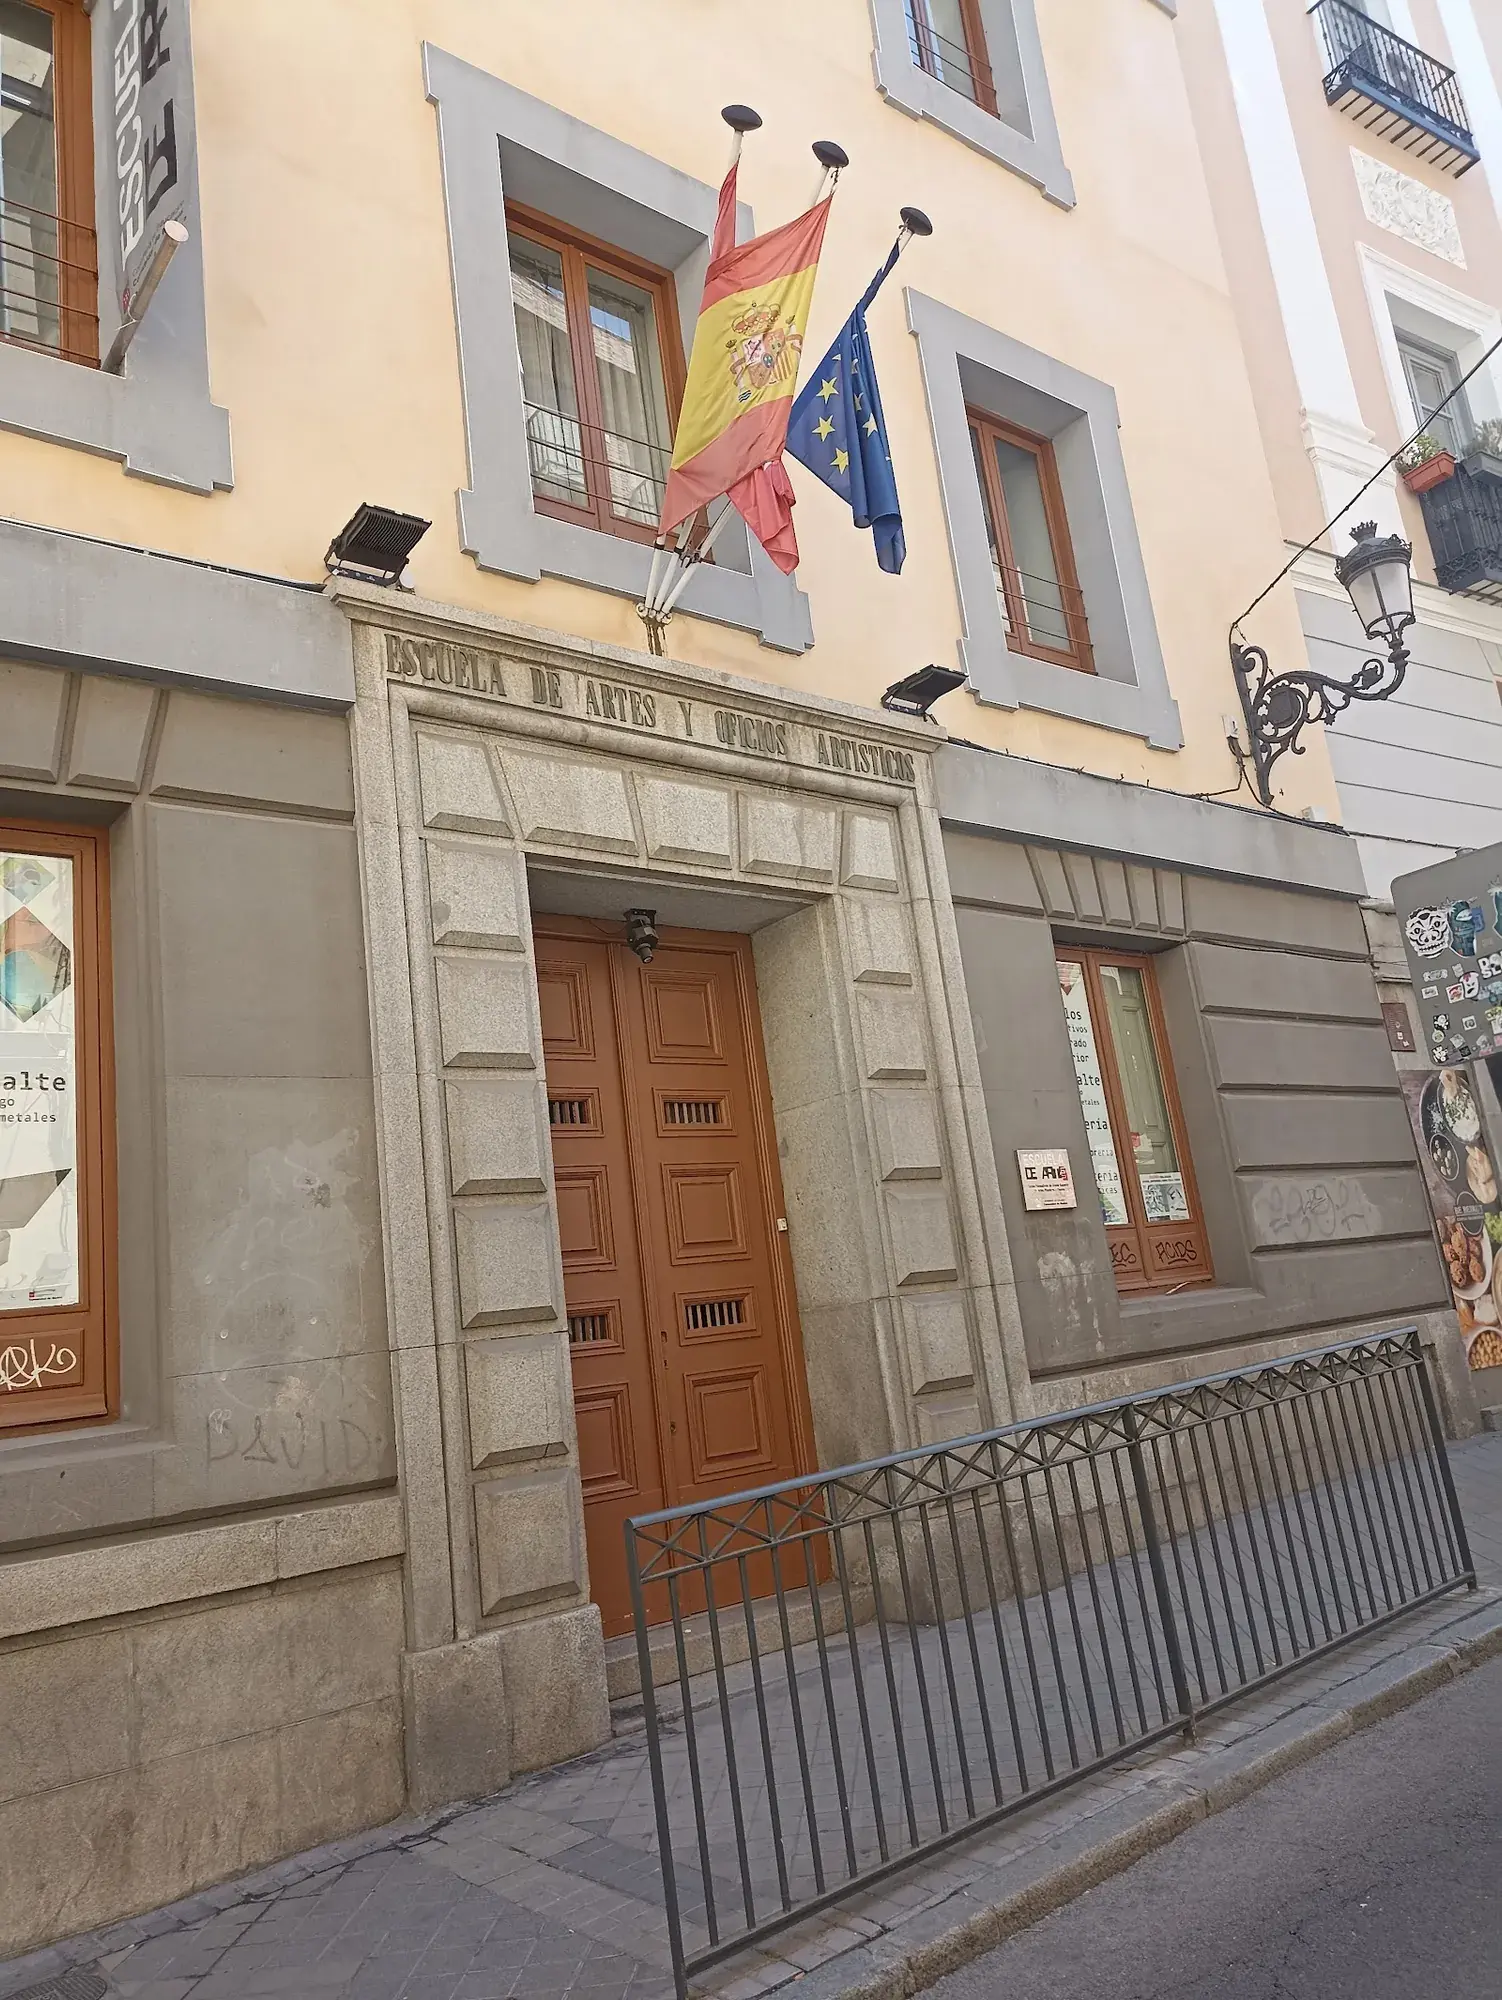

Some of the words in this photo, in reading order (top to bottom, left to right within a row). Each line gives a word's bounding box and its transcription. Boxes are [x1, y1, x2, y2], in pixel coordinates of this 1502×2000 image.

[113, 0, 145, 272] ESCUEL
[384, 633, 507, 697] ESCUELA
[530, 666, 564, 709] DE
[586, 680, 656, 728] ARTES
[678, 700, 695, 737] Y
[714, 710, 786, 756] OFICIOS
[817, 733, 916, 783] ARTISTICOS
[1021, 1154, 1064, 1166] ESCUELA
